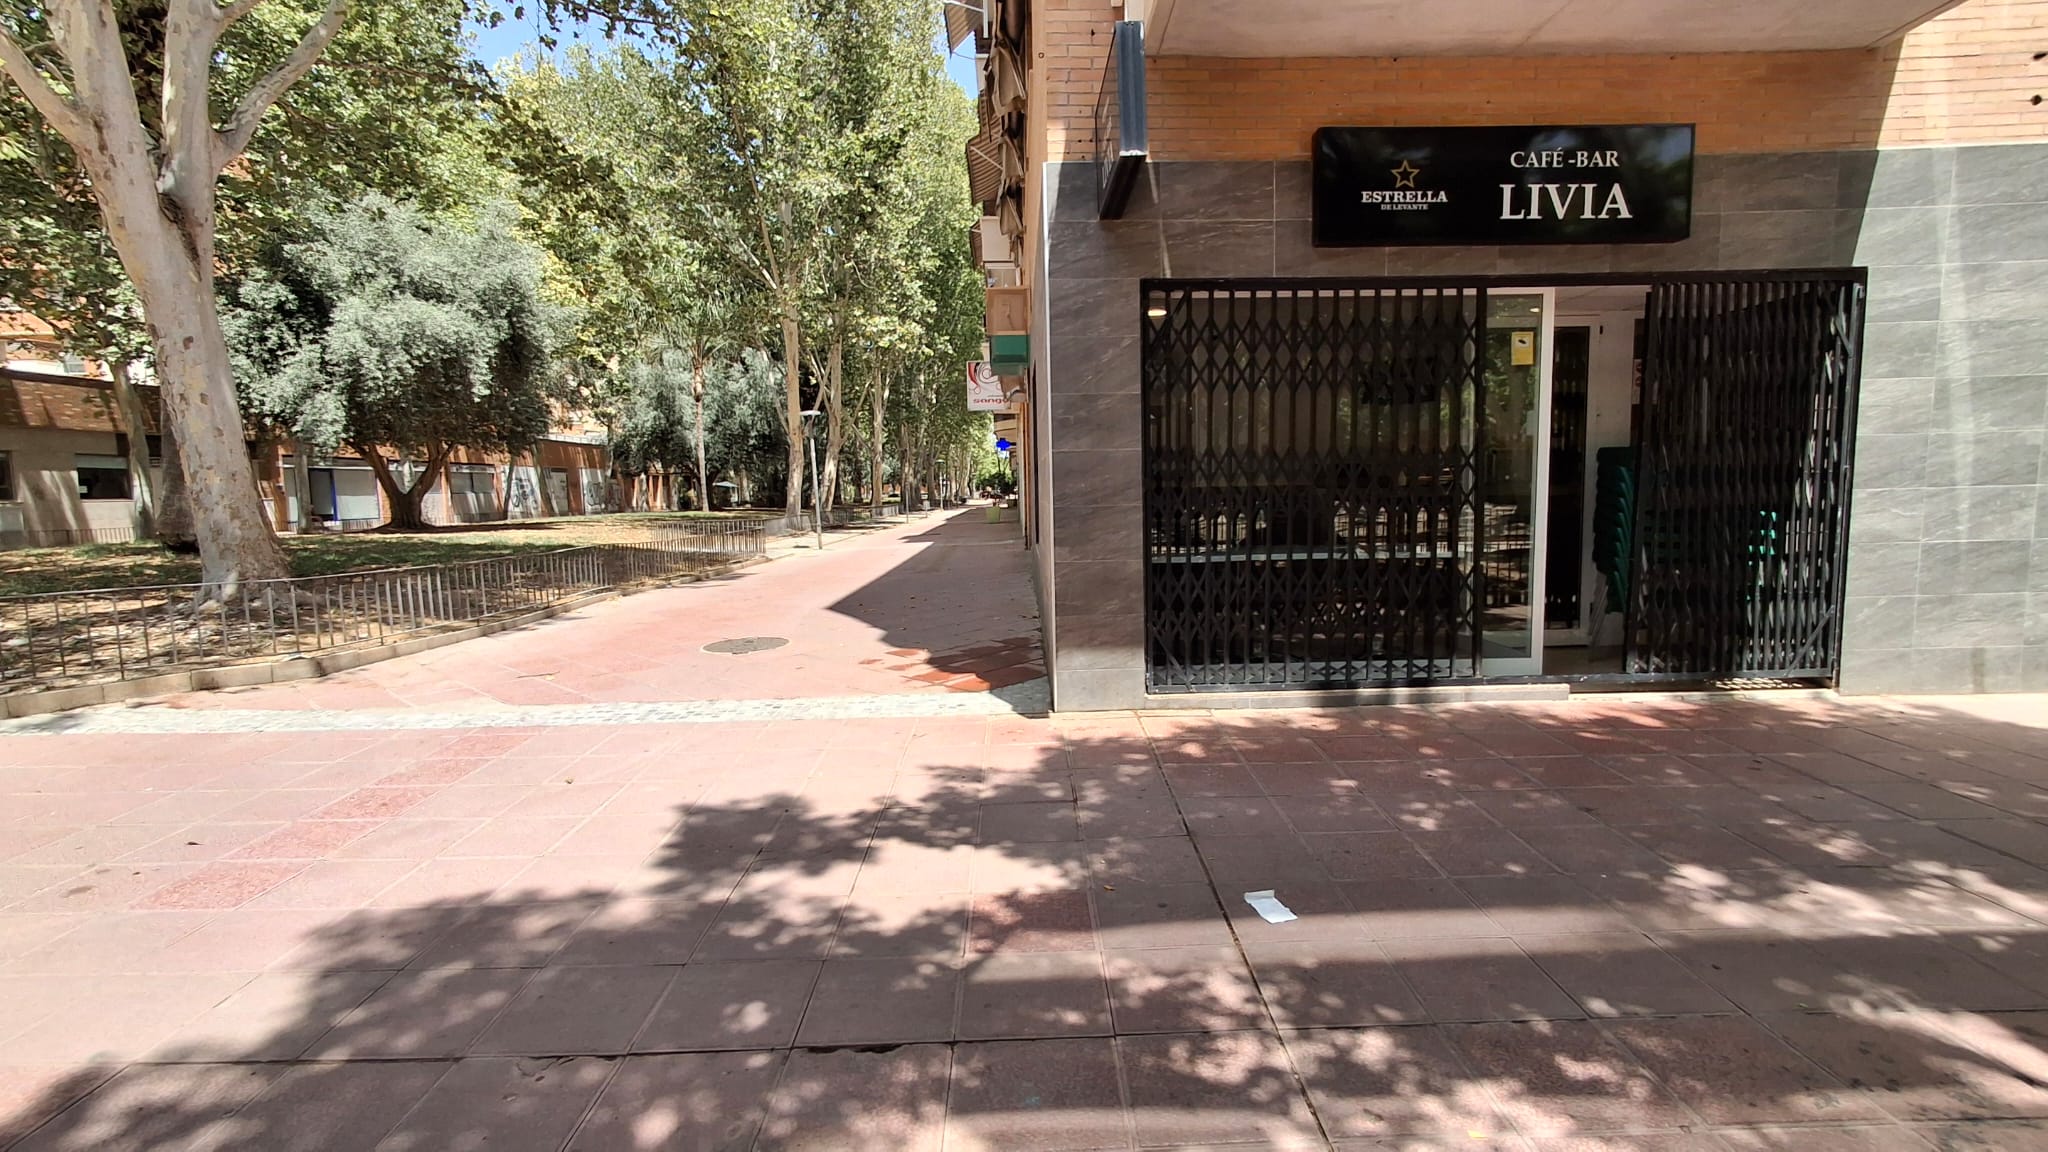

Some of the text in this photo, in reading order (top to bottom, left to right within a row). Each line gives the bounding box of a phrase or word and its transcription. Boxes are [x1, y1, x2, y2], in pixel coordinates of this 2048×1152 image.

[1361, 190, 1448, 203] ESTRELLA
[1499, 182, 1633, 220] LIVIA
[1380, 203, 1429, 211] DE LEVANTE
